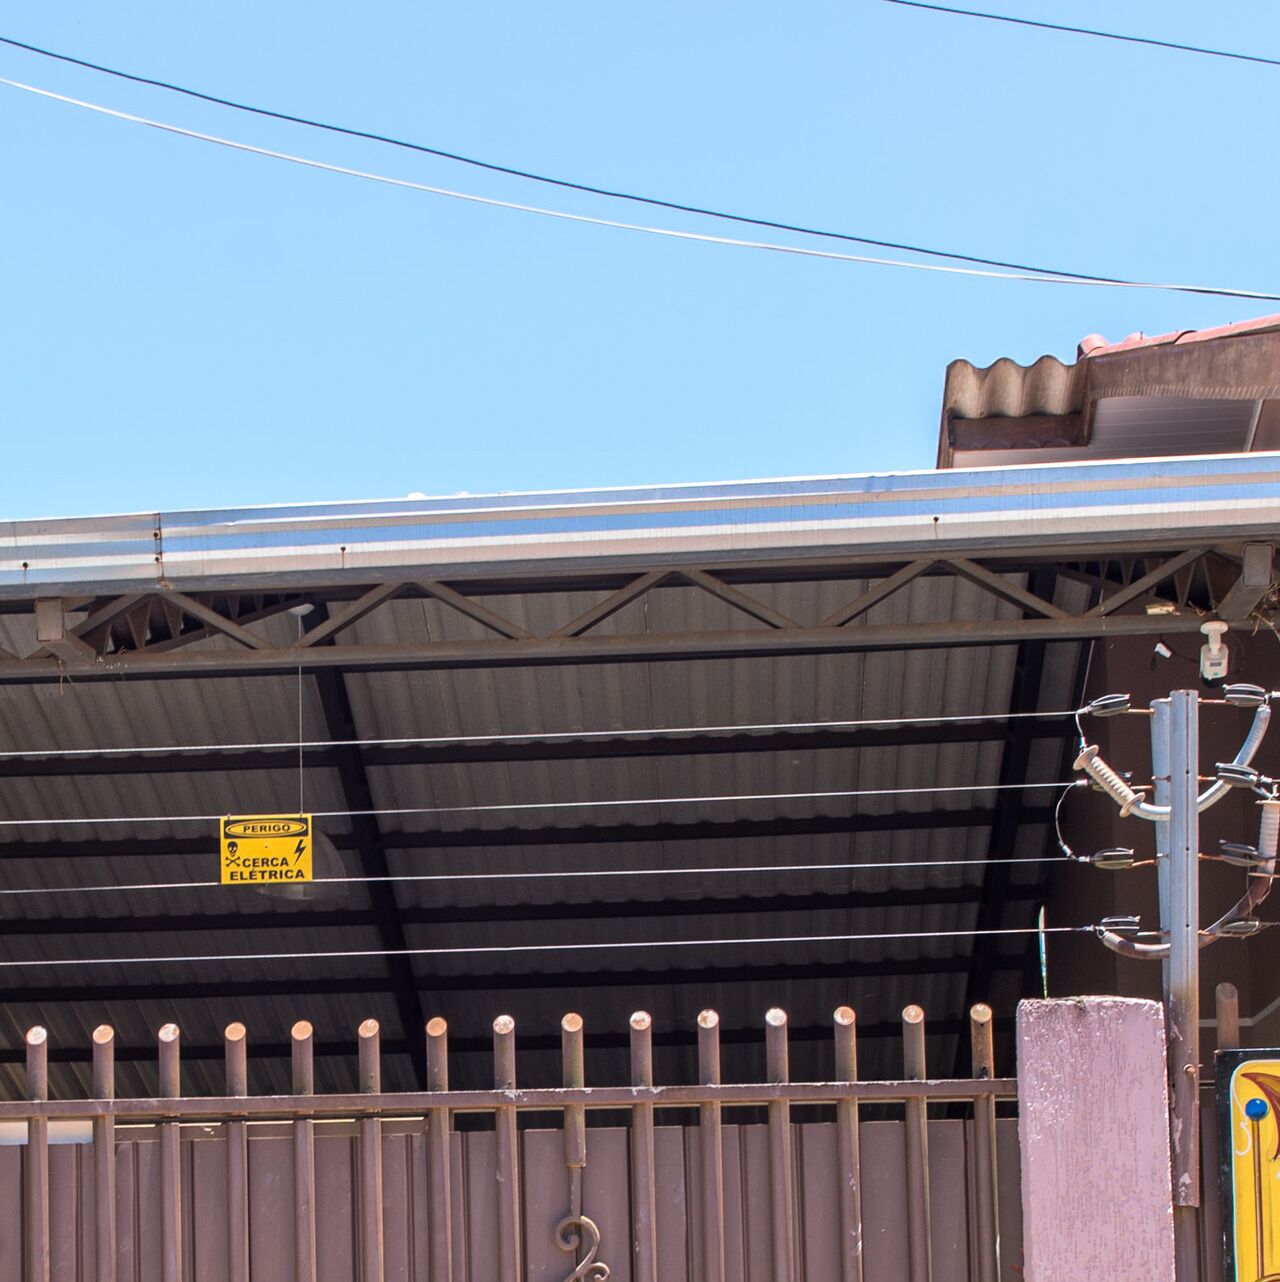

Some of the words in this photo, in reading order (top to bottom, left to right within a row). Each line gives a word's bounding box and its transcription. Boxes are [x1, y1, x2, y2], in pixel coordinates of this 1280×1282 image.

[243, 824, 291, 833] PERIGO
[242, 857, 289, 868] CERCA
[230, 868, 305, 881] ELÉTRICA
